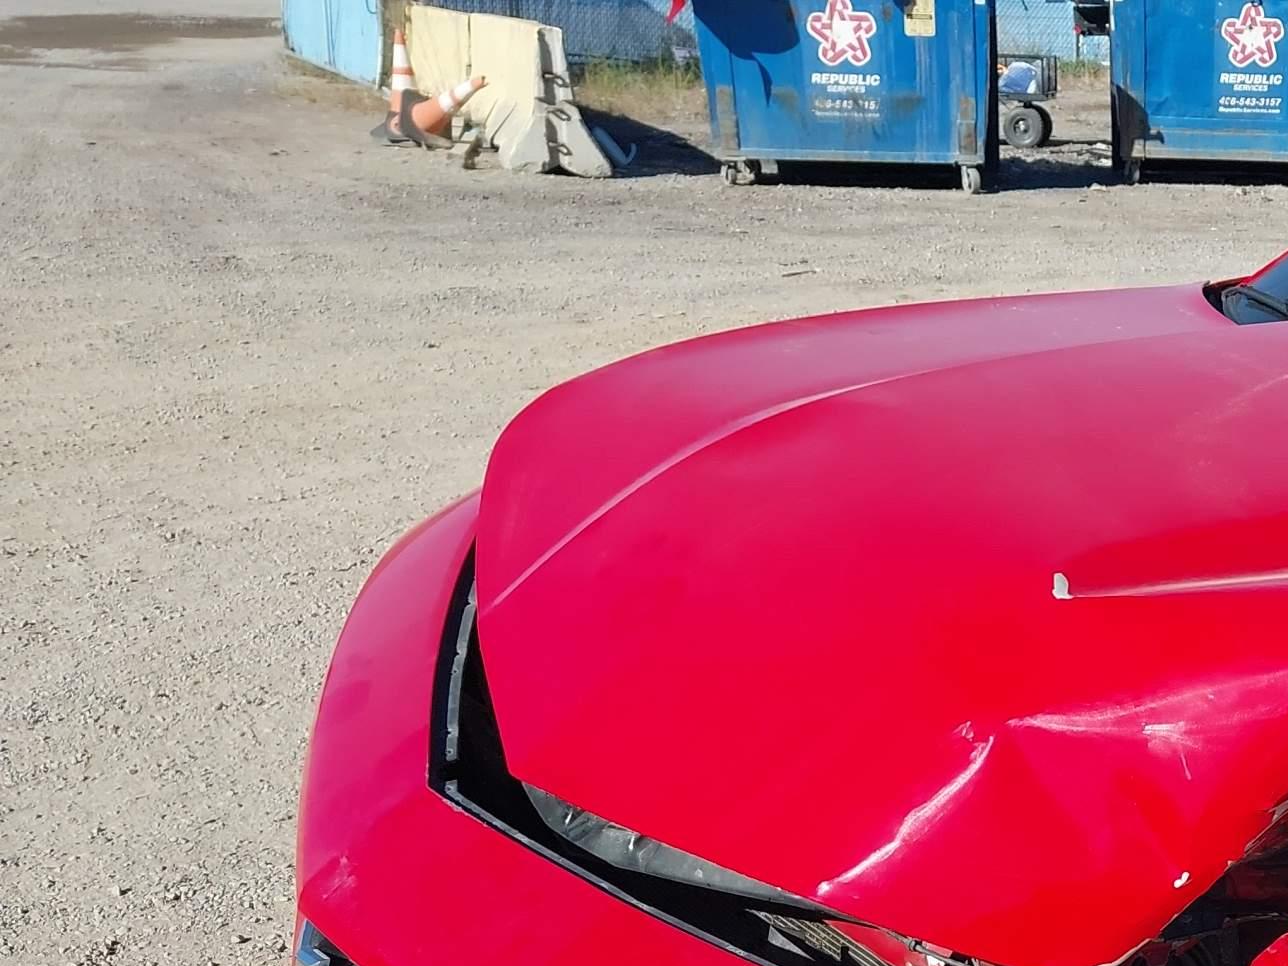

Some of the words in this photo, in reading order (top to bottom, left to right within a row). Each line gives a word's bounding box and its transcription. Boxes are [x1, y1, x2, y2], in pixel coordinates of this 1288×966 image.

[811, 73, 881, 86] REPUBLIC
[1220, 73, 1283, 85] REPUBLIC
[1233, 84, 1268, 92] SERVICES
